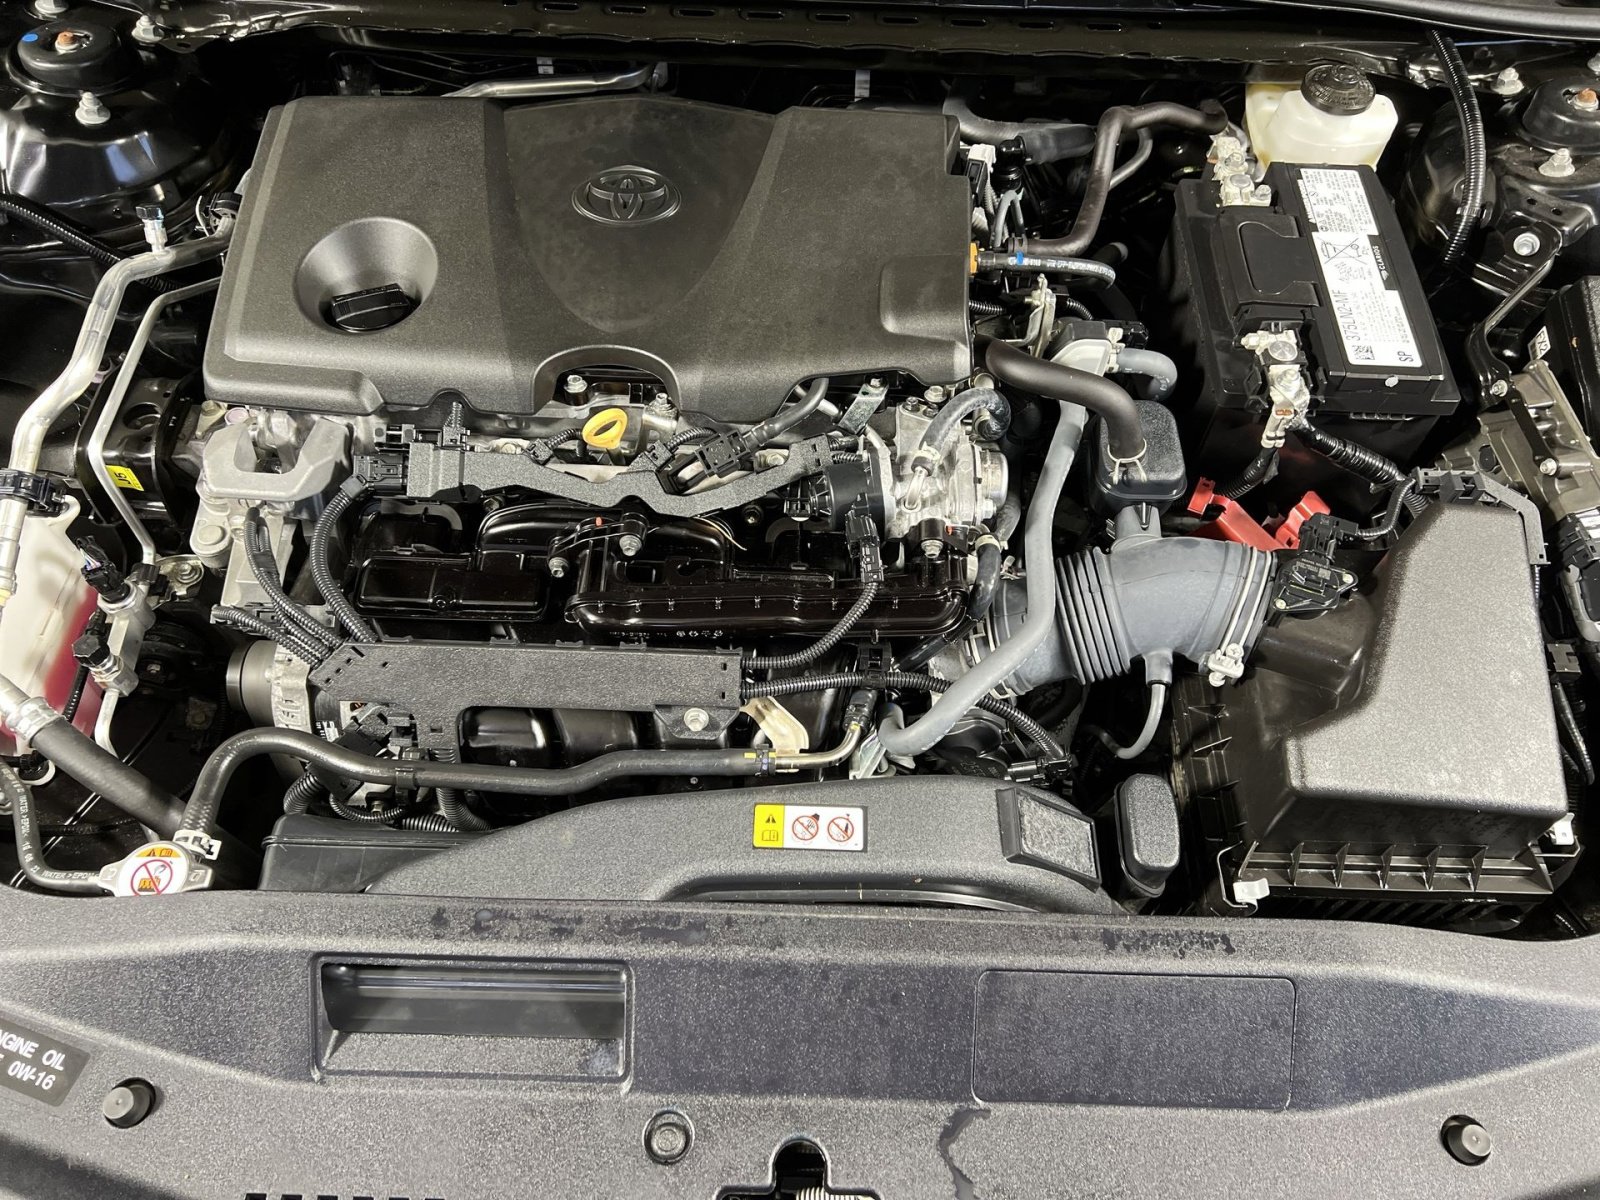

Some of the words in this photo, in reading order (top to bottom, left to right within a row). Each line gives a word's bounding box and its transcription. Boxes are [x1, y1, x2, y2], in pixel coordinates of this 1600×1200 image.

[1373, 245, 1386, 271] CLARIOS
[1332, 290, 1361, 341] 375LN2-MF
[1397, 351, 1414, 362] SP
[20, 795, 29, 814] WATER
[41, 870, 66, 879] WATER
[42, 1050, 66, 1070] OIL
[8, 1061, 56, 1090] 0W-16
